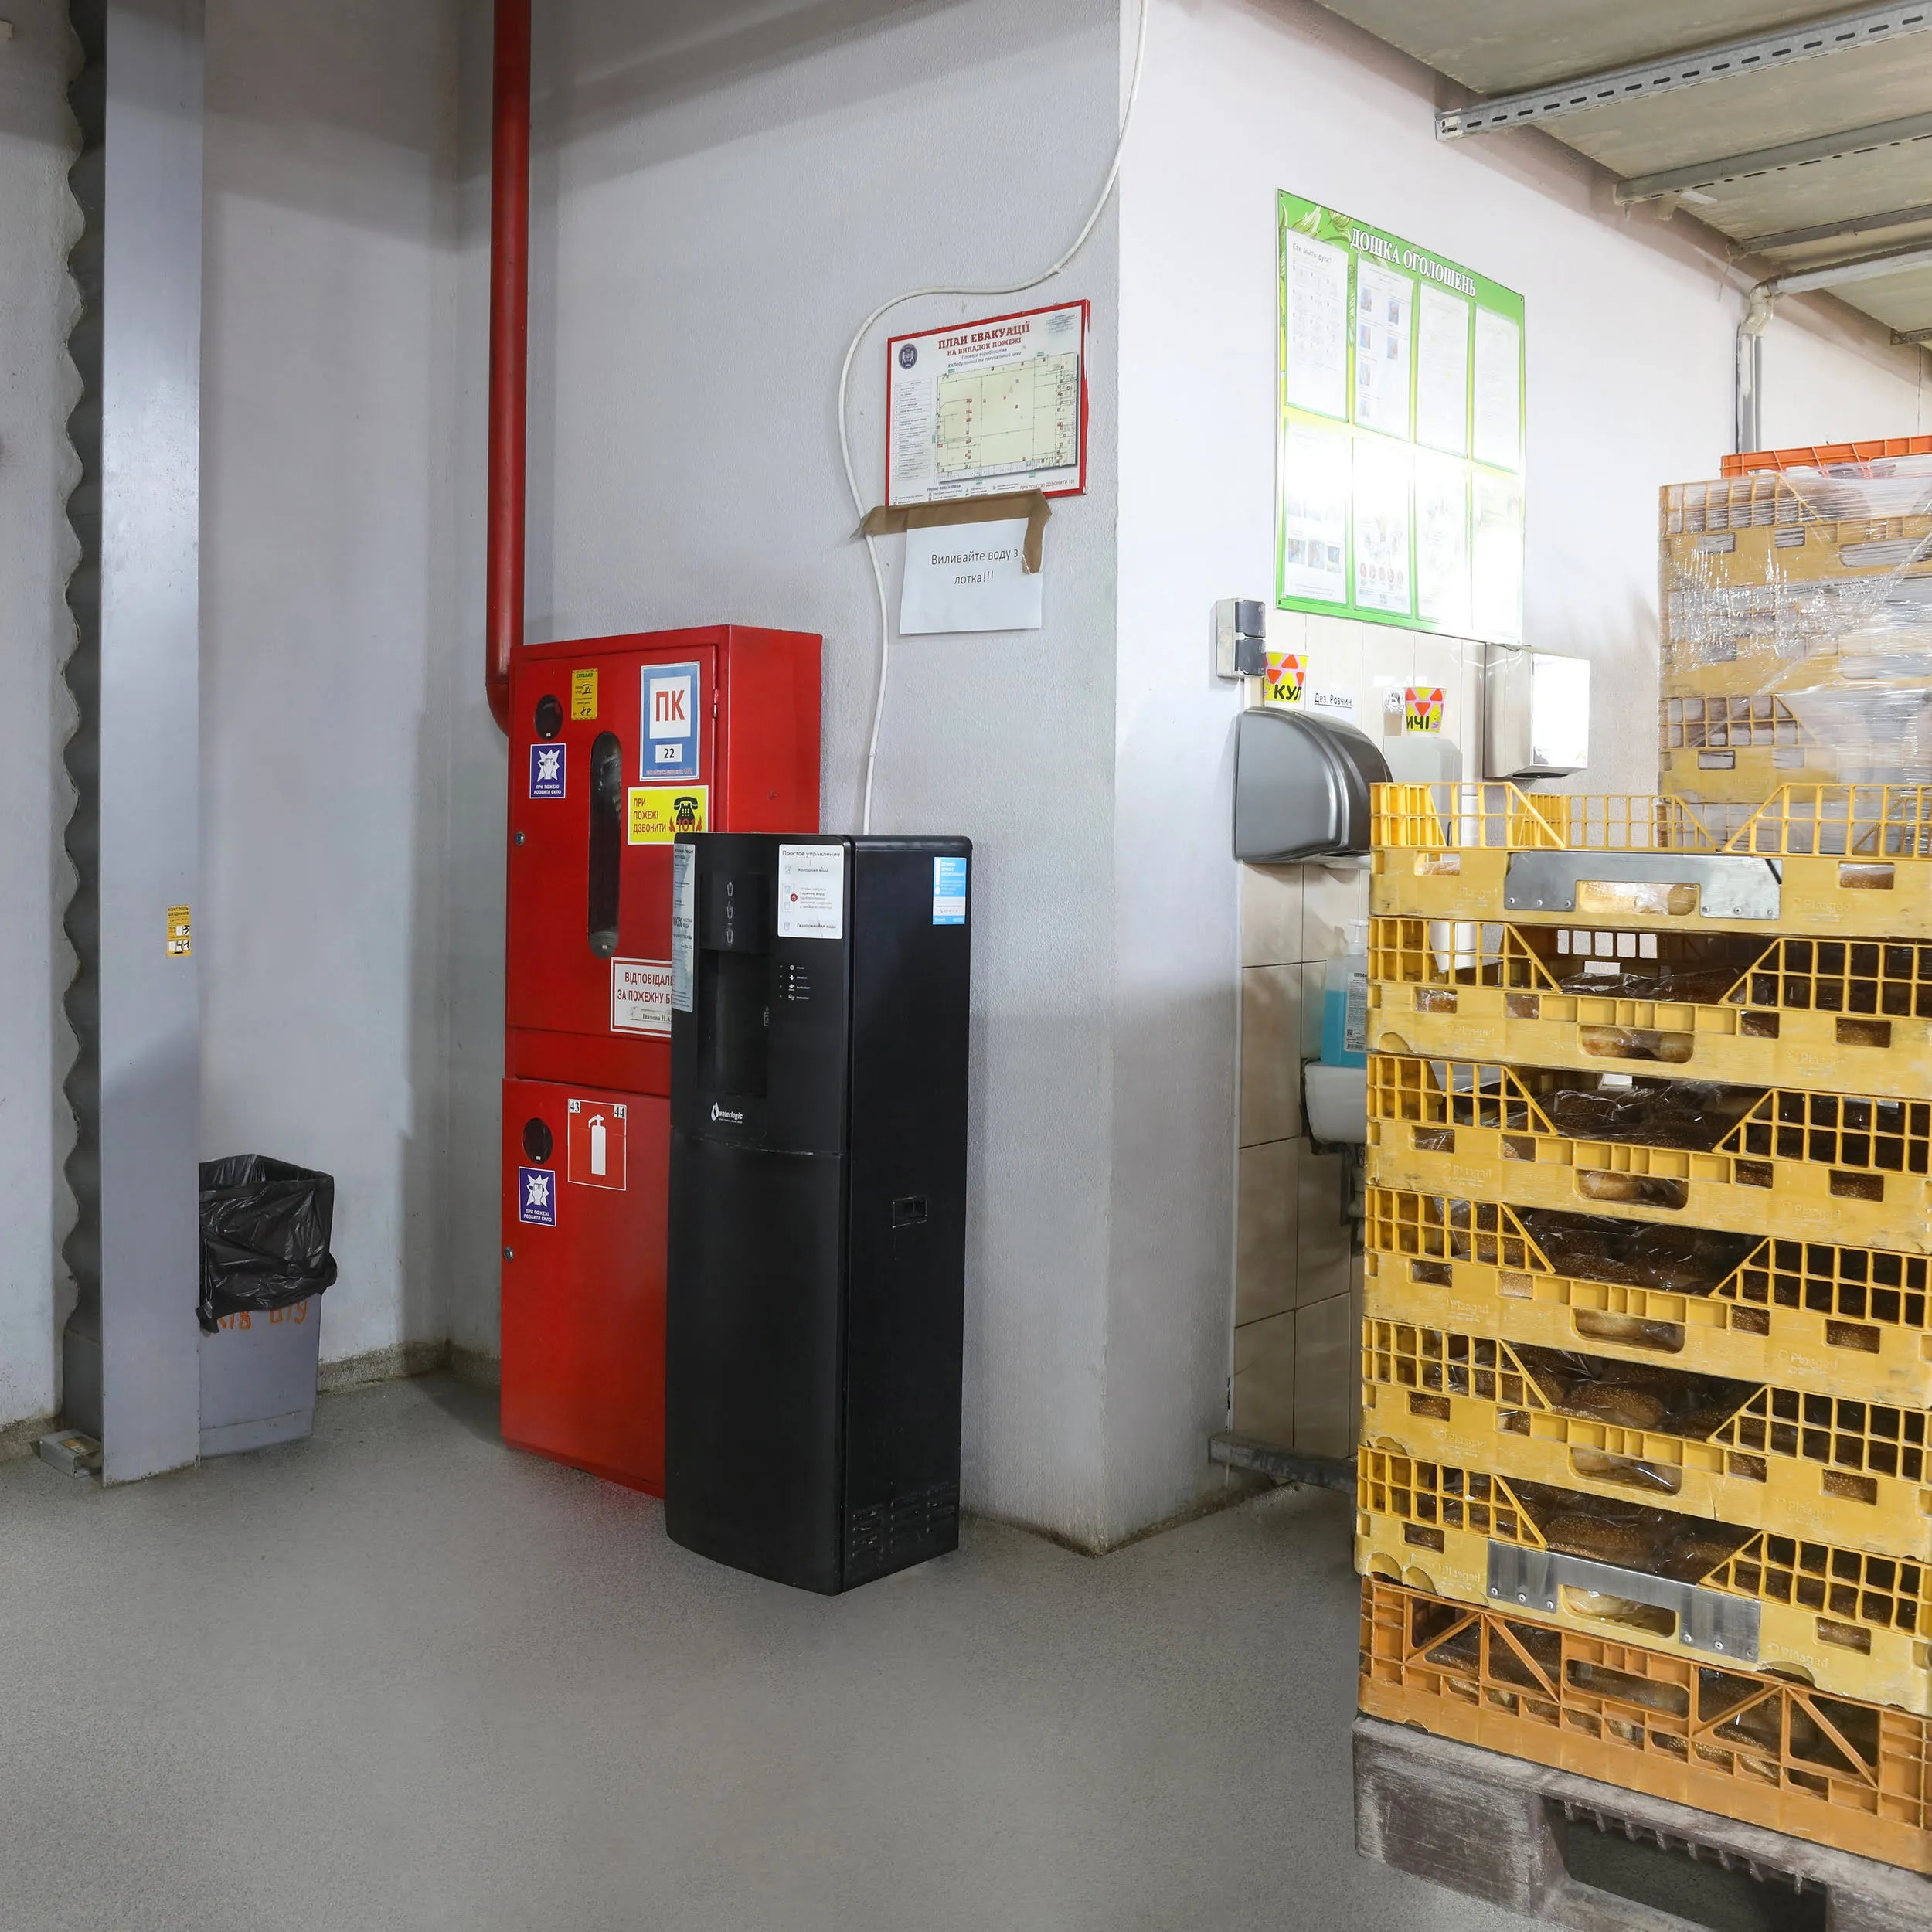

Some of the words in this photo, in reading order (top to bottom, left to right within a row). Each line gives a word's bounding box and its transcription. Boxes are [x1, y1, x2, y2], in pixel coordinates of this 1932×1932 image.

[1349, 227, 1400, 265] ДОШКА
[1403, 249, 1476, 298] ОГОЛОШЕНЬ
[938, 335, 968, 349] ПЛАН
[971, 321, 1031, 343] ЕВАКУАЦІЇ
[958, 343, 991, 354] ВИПАДОК
[992, 337, 1022, 348] ПОЖЕЖІ
[931, 551, 985, 565] Виливайте
[988, 549, 1011, 560] воду
[1013, 549, 1019, 558] з
[954, 570, 995, 585] лотка!!!
[655, 689, 685, 722] ПК
[663, 747, 675, 758] 22
[633, 798, 646, 807] ПРИ
[633, 811, 658, 819] ПОЖЕЖІ
[633, 823, 667, 834] ДЗВОНИТИ
[677, 818, 696, 832] 101
[617, 989, 627, 1000] ЗА
[628, 990, 664, 1004] ПОЖЕЖНУ
[666, 994, 672, 1004] Б
[570, 1101, 580, 1113] 43
[614, 1107, 624, 1117] 44
